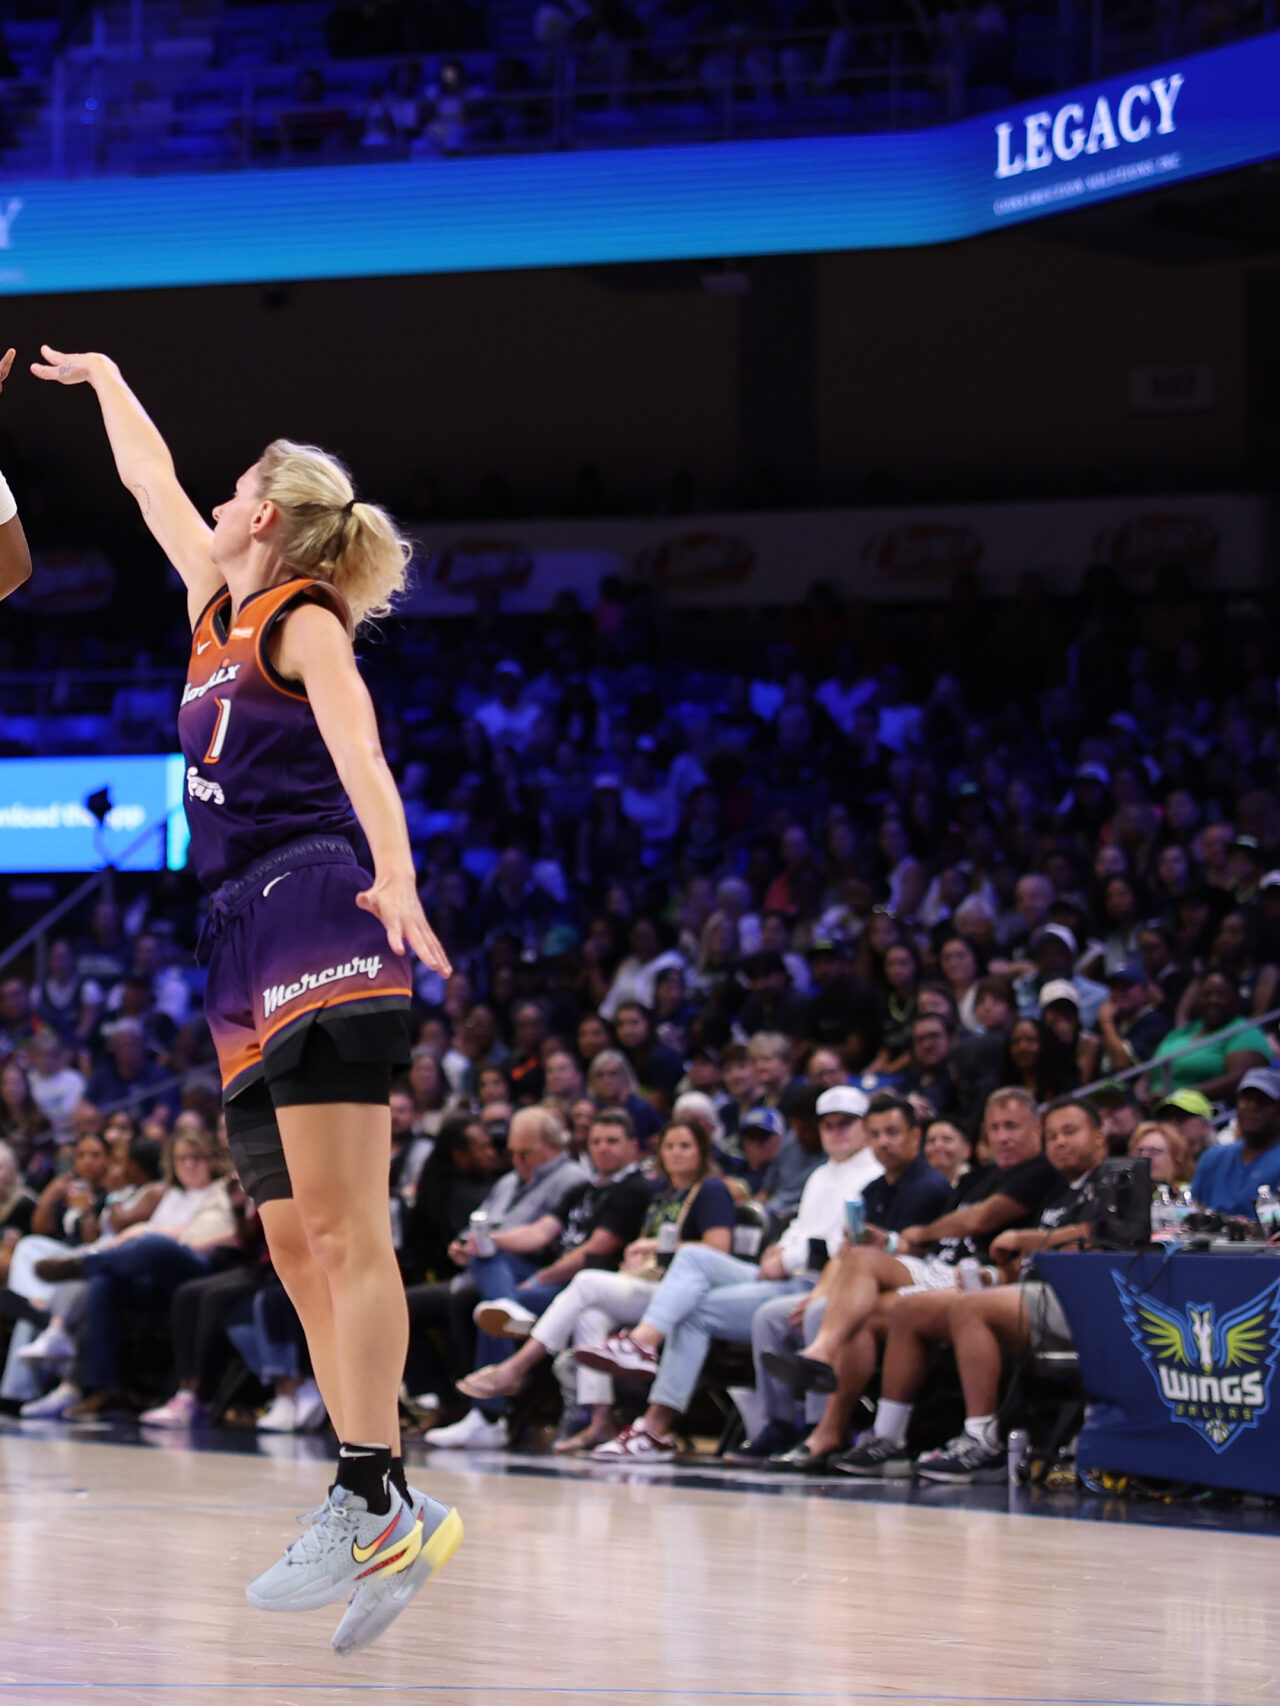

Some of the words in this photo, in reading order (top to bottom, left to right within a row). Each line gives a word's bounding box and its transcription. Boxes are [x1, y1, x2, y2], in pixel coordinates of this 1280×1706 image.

[994, 73, 1185, 179] LEGACY
[262, 955, 383, 1019] Mercury
[1157, 1363, 1266, 1407] WINGS
